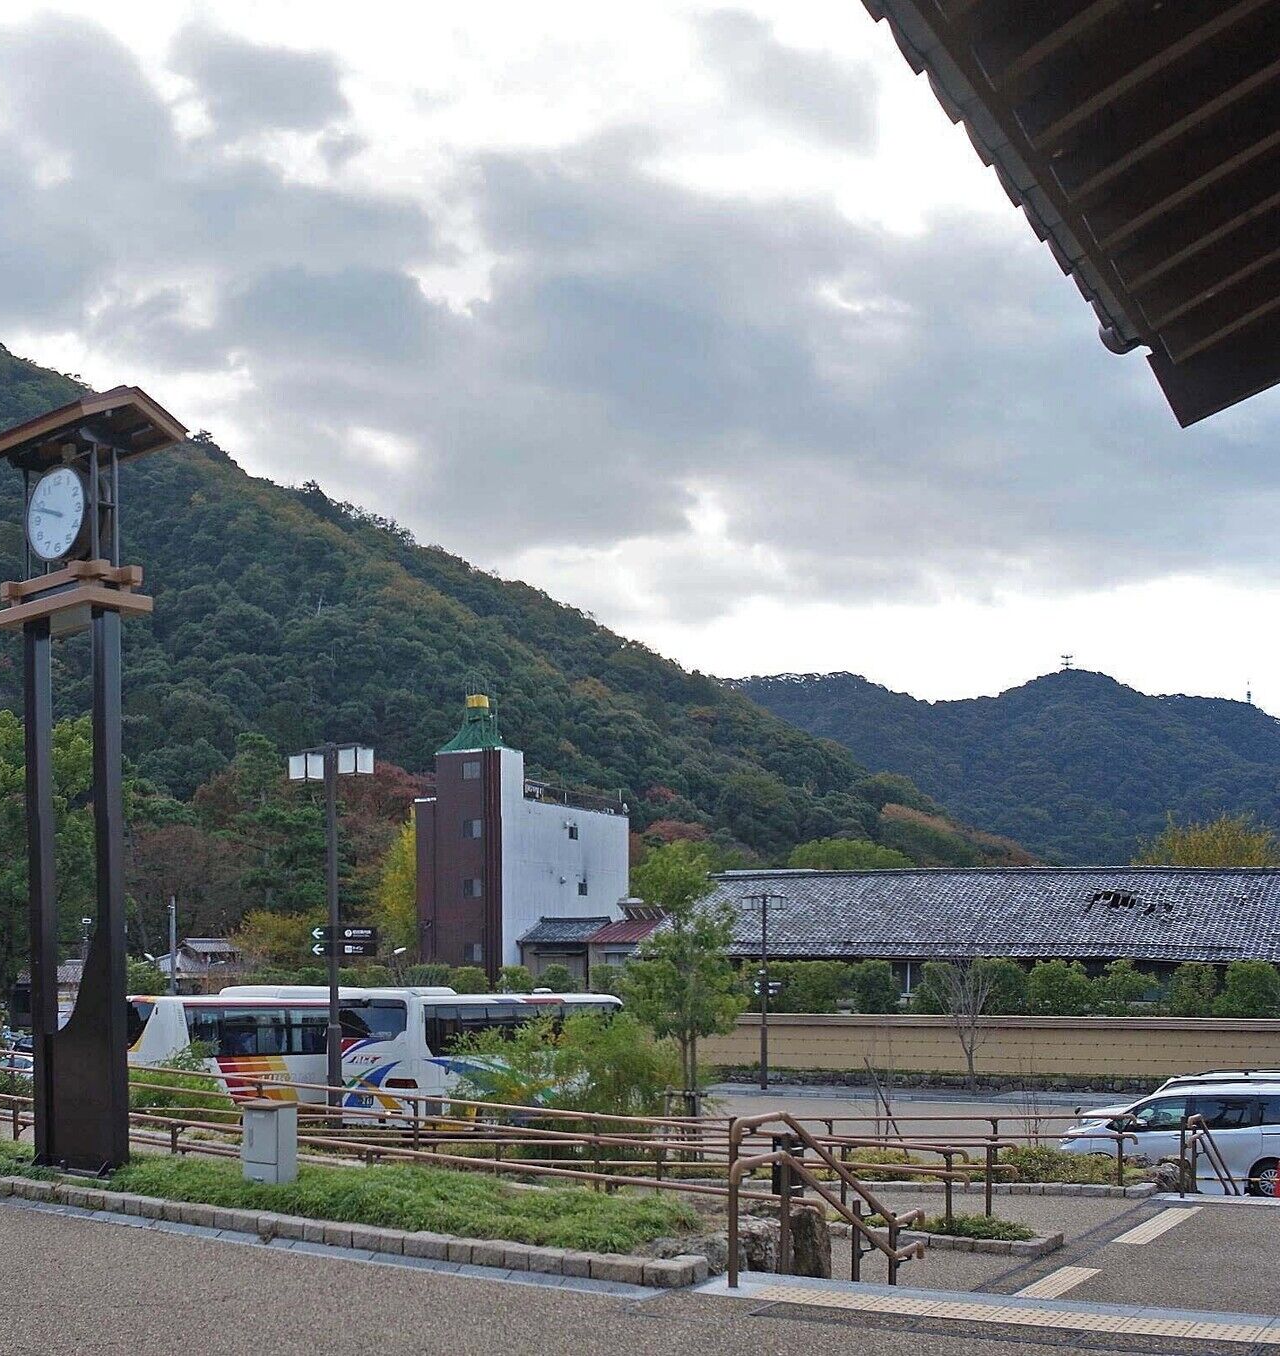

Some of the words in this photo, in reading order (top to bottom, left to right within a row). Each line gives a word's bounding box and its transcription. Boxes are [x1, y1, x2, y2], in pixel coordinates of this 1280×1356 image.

[43, 486, 51, 496] 11
[72, 486, 79, 497] 2
[74, 502, 81, 513] 3
[35, 515, 41, 526] 9
[71, 519, 79, 529] 4
[37, 531, 43, 541] 8
[65, 533, 72, 544] 5
[45, 541, 51, 551] 7
[54, 542, 61, 553] 6
